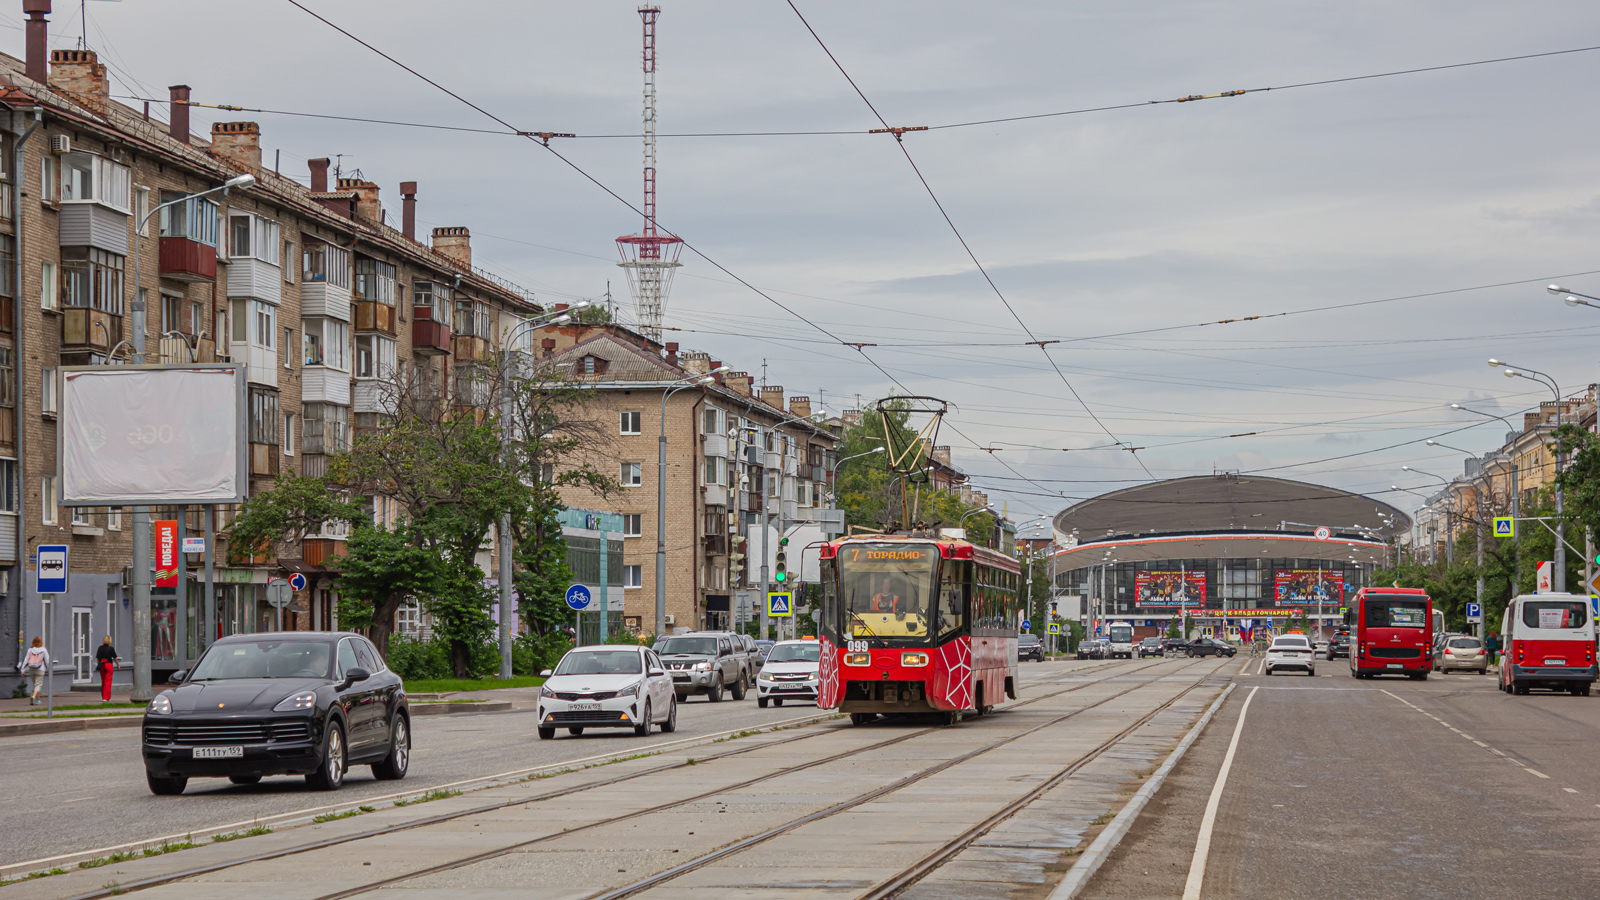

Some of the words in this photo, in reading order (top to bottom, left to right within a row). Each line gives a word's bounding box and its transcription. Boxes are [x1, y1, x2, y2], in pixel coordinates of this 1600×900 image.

[161, 527, 173, 566] ПОБЕДА!
[851, 549, 860, 562] 7
[867, 551, 926, 559] ТОРАДИО-
[1470, 604, 1479, 616] P
[847, 640, 868, 652] 099
[195, 748, 226, 757] Е111ТУ
[228, 746, 240, 754] 159
